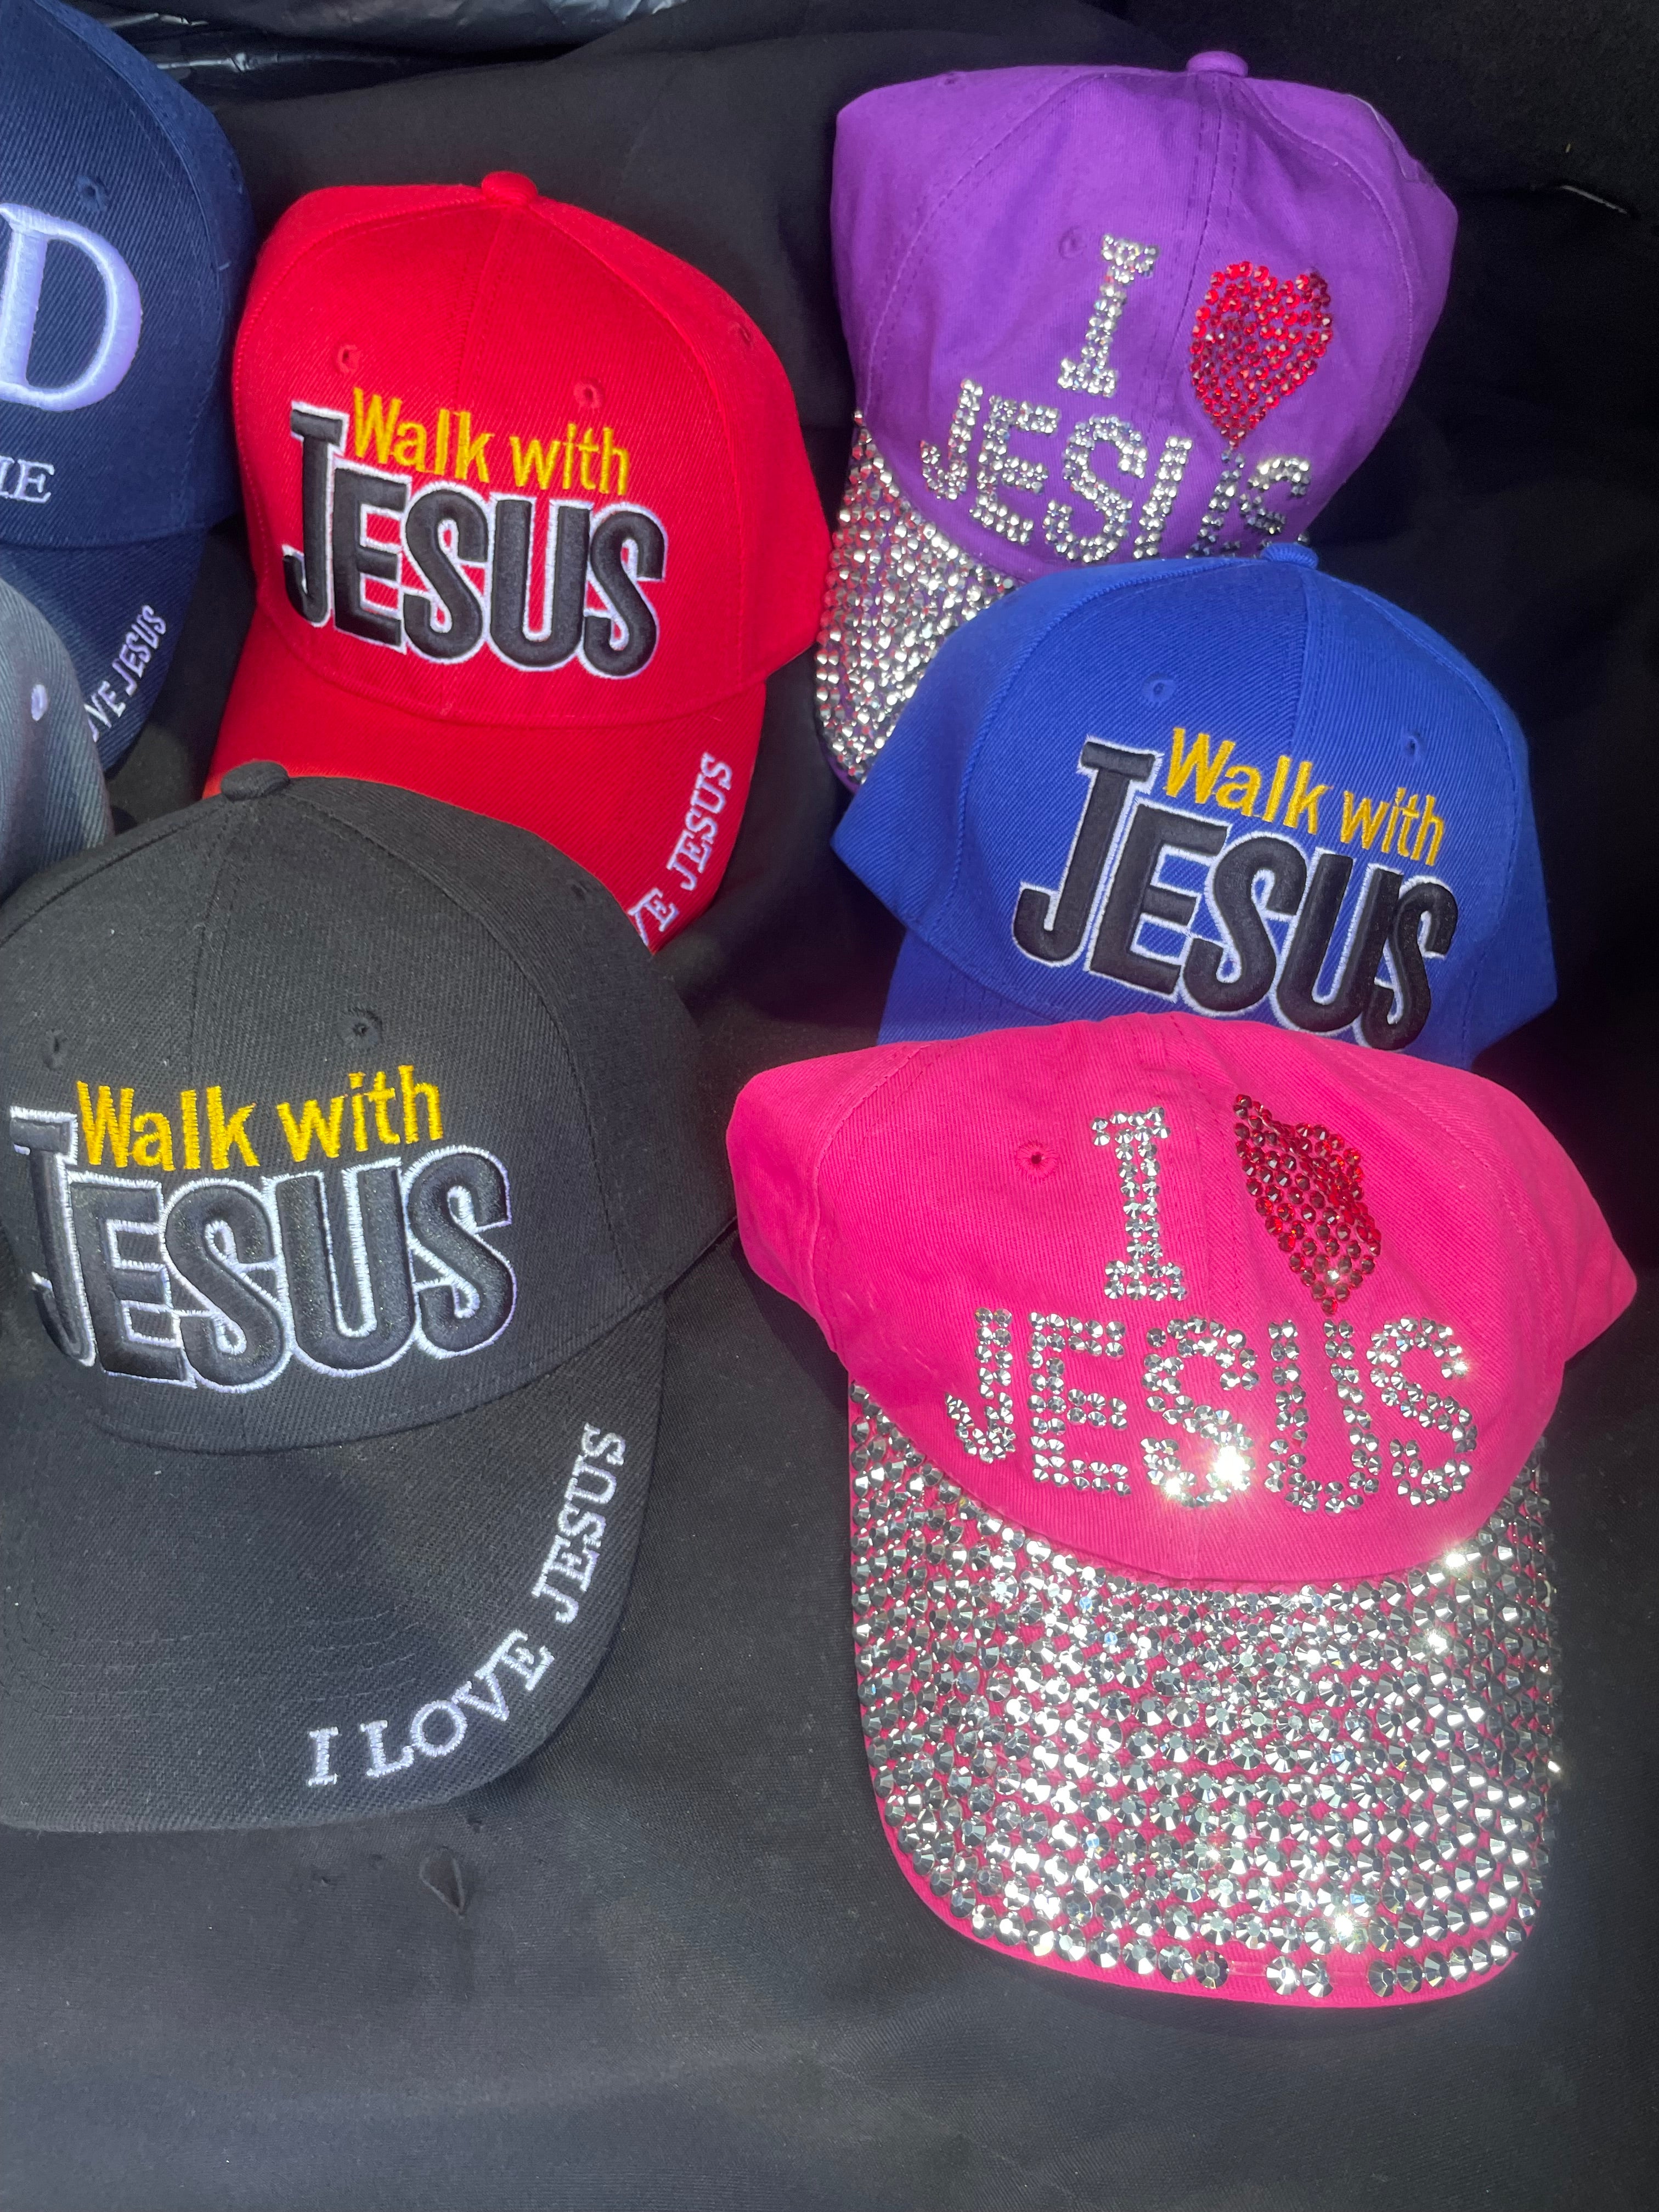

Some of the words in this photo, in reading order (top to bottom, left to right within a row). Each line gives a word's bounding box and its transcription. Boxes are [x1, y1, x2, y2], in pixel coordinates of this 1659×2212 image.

[1057, 234, 1159, 398] I
[353, 387, 494, 483] Walk
[510, 424, 630, 495] with
[281, 400, 669, 680] JESUS
[83, 680, 126, 742] VE
[112, 605, 166, 697] JESUS
[666, 752, 732, 891] JESUS
[1162, 727, 1330, 834] Walk
[1340, 787, 1446, 866] with
[1012, 736, 1459, 1051] JESUS
[77, 1081, 260, 1171] Walk
[276, 1065, 443, 1163] with
[1091, 1106, 1188, 1302] I
[9, 1106, 517, 1394] JESUS
[945, 1307, 1477, 1513] JESUS
[308, 1726, 339, 1786] I
[360, 1629, 555, 1778] LOVE
[532, 1422, 625, 1624] JESUS
